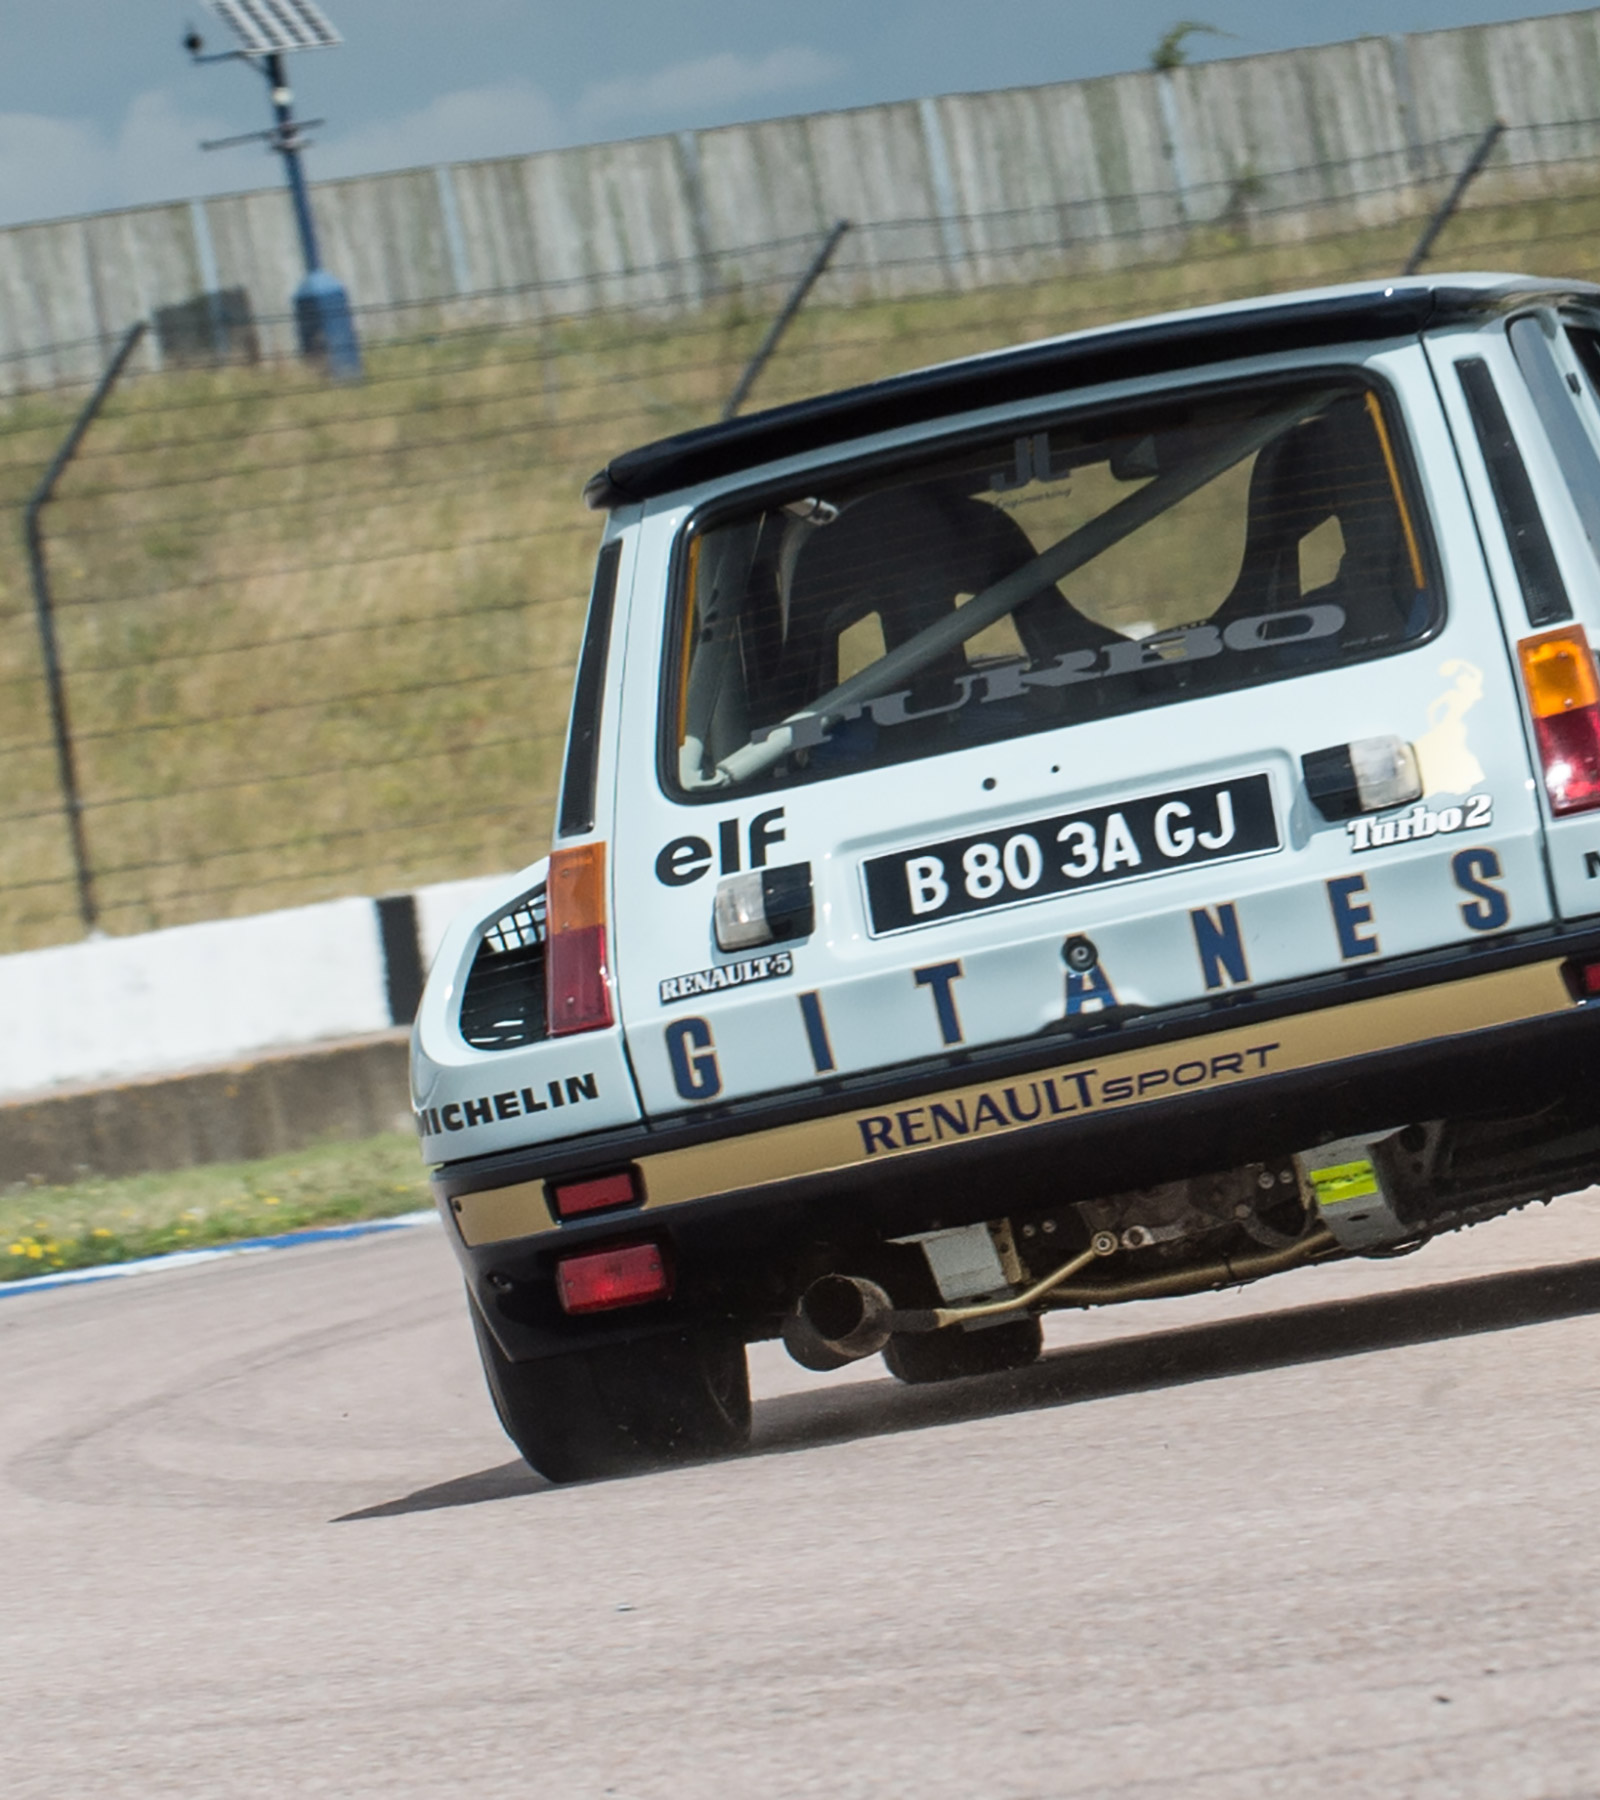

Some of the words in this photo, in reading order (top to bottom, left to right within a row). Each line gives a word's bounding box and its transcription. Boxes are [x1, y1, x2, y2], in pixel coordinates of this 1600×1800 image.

[751, 604, 1346, 748] TURBO
[654, 806, 786, 887] elf
[663, 846, 1511, 1102] GITANES
